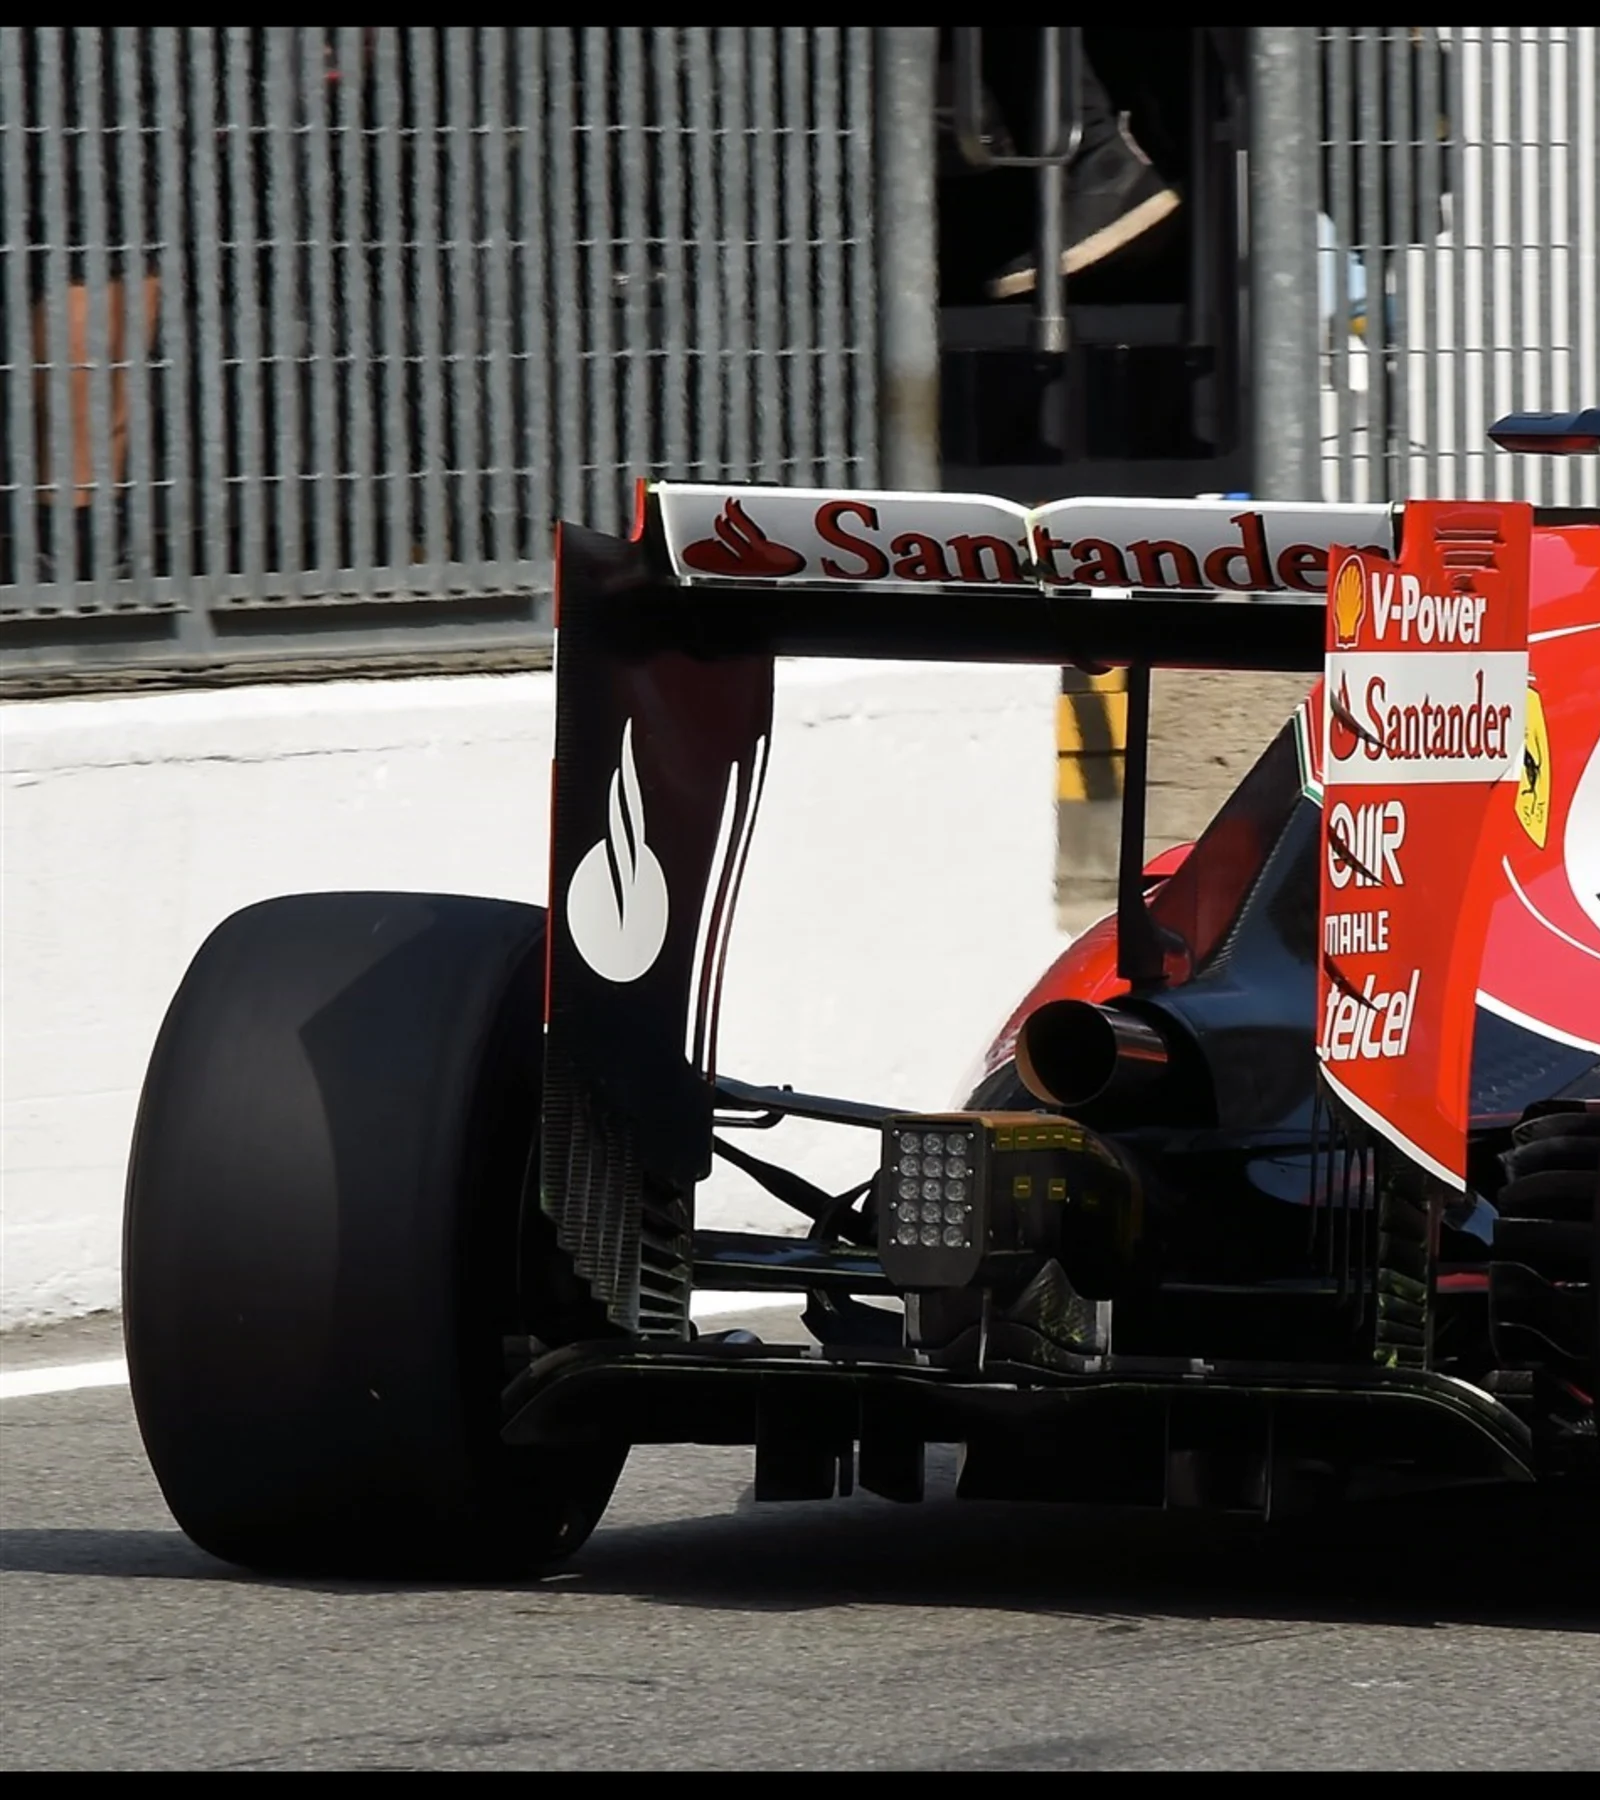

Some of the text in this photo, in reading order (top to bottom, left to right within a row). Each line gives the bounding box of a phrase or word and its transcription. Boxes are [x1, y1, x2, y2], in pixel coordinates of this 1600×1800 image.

[814, 500, 1390, 594] Santande
[1371, 571, 1487, 645] V-Power
[1364, 668, 1512, 762] Santander
[1325, 910, 1389, 956] MAHLE
[1316, 968, 1421, 1062] telcel
